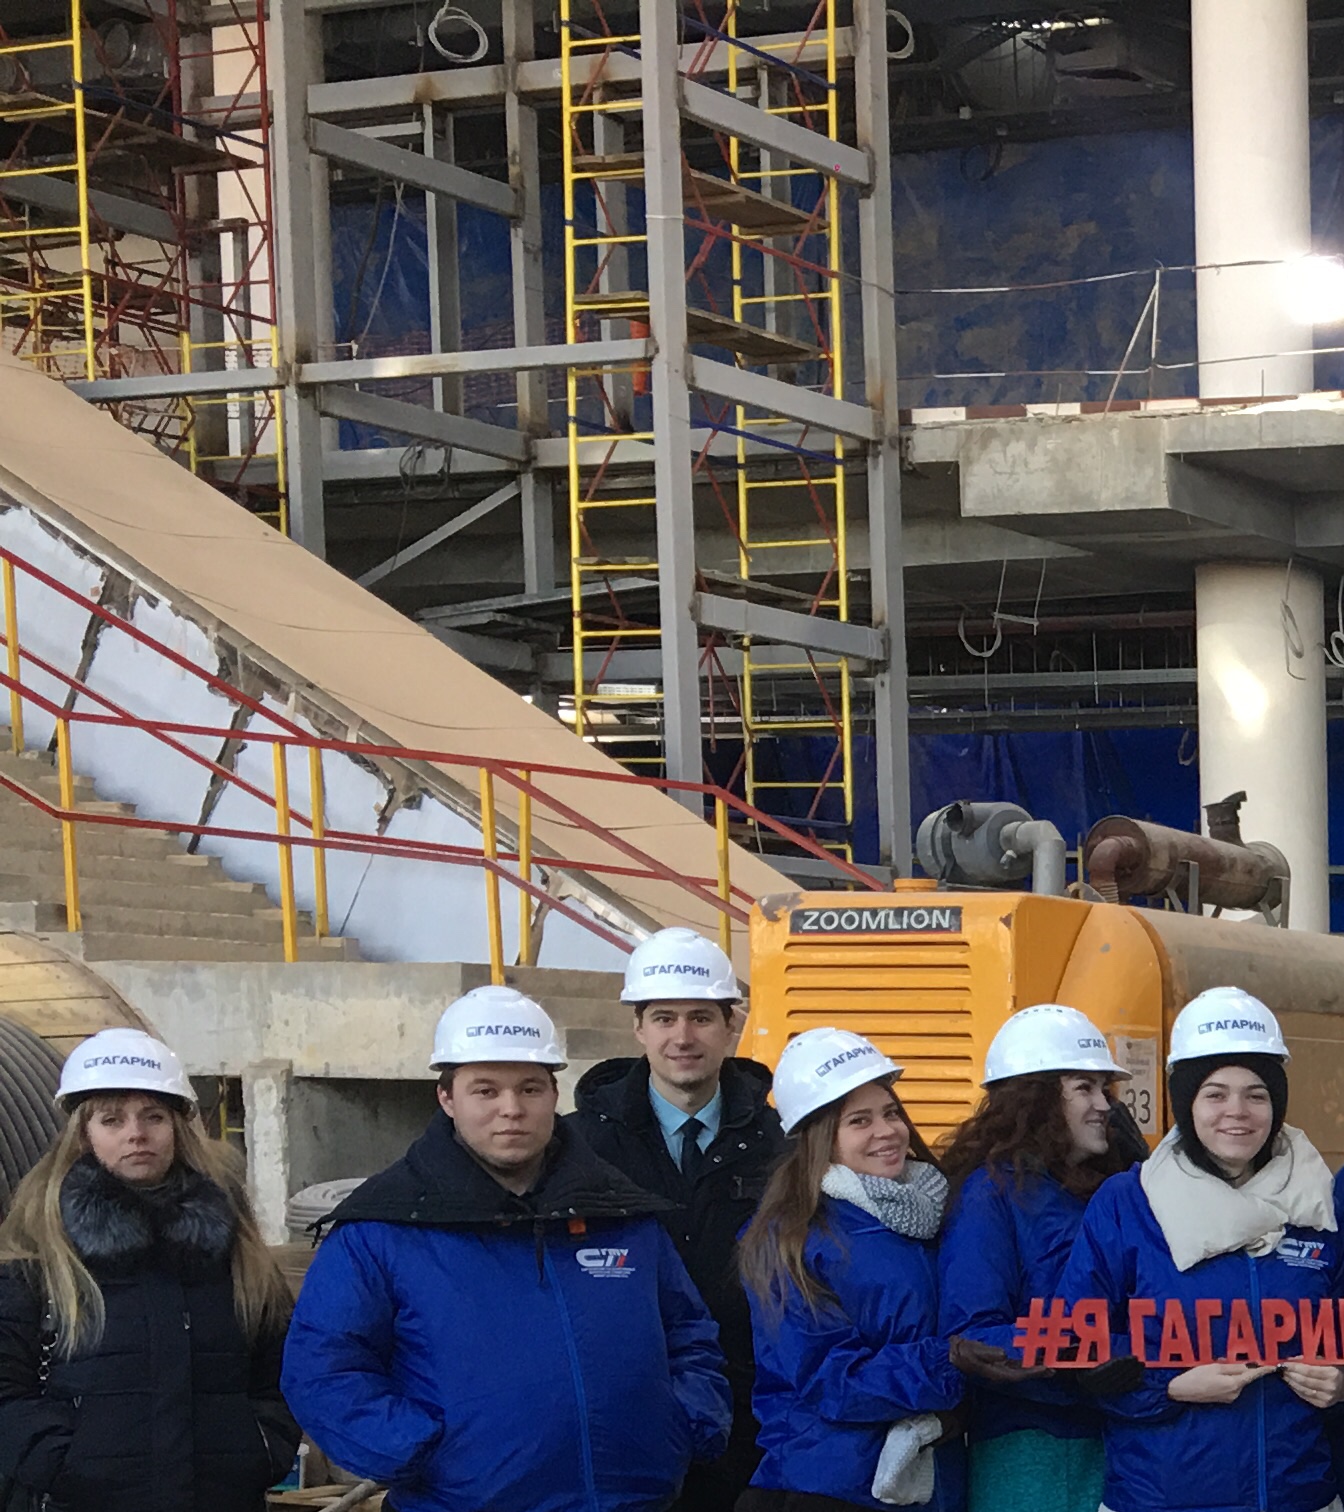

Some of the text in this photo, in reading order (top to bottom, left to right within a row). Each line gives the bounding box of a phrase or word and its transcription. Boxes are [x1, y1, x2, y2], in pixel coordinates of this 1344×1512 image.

[802, 909, 951, 930] ZOOMLION
[652, 964, 710, 978] ГАГАРИН
[477, 1025, 541, 1038] ГАГАРИН
[1207, 1019, 1266, 1033] ГАГАРИН
[94, 1056, 162, 1070] ГАГАРИН
[825, 1046, 877, 1071] ГАГАРИН
[1012, 1297, 1111, 1369] #Я
